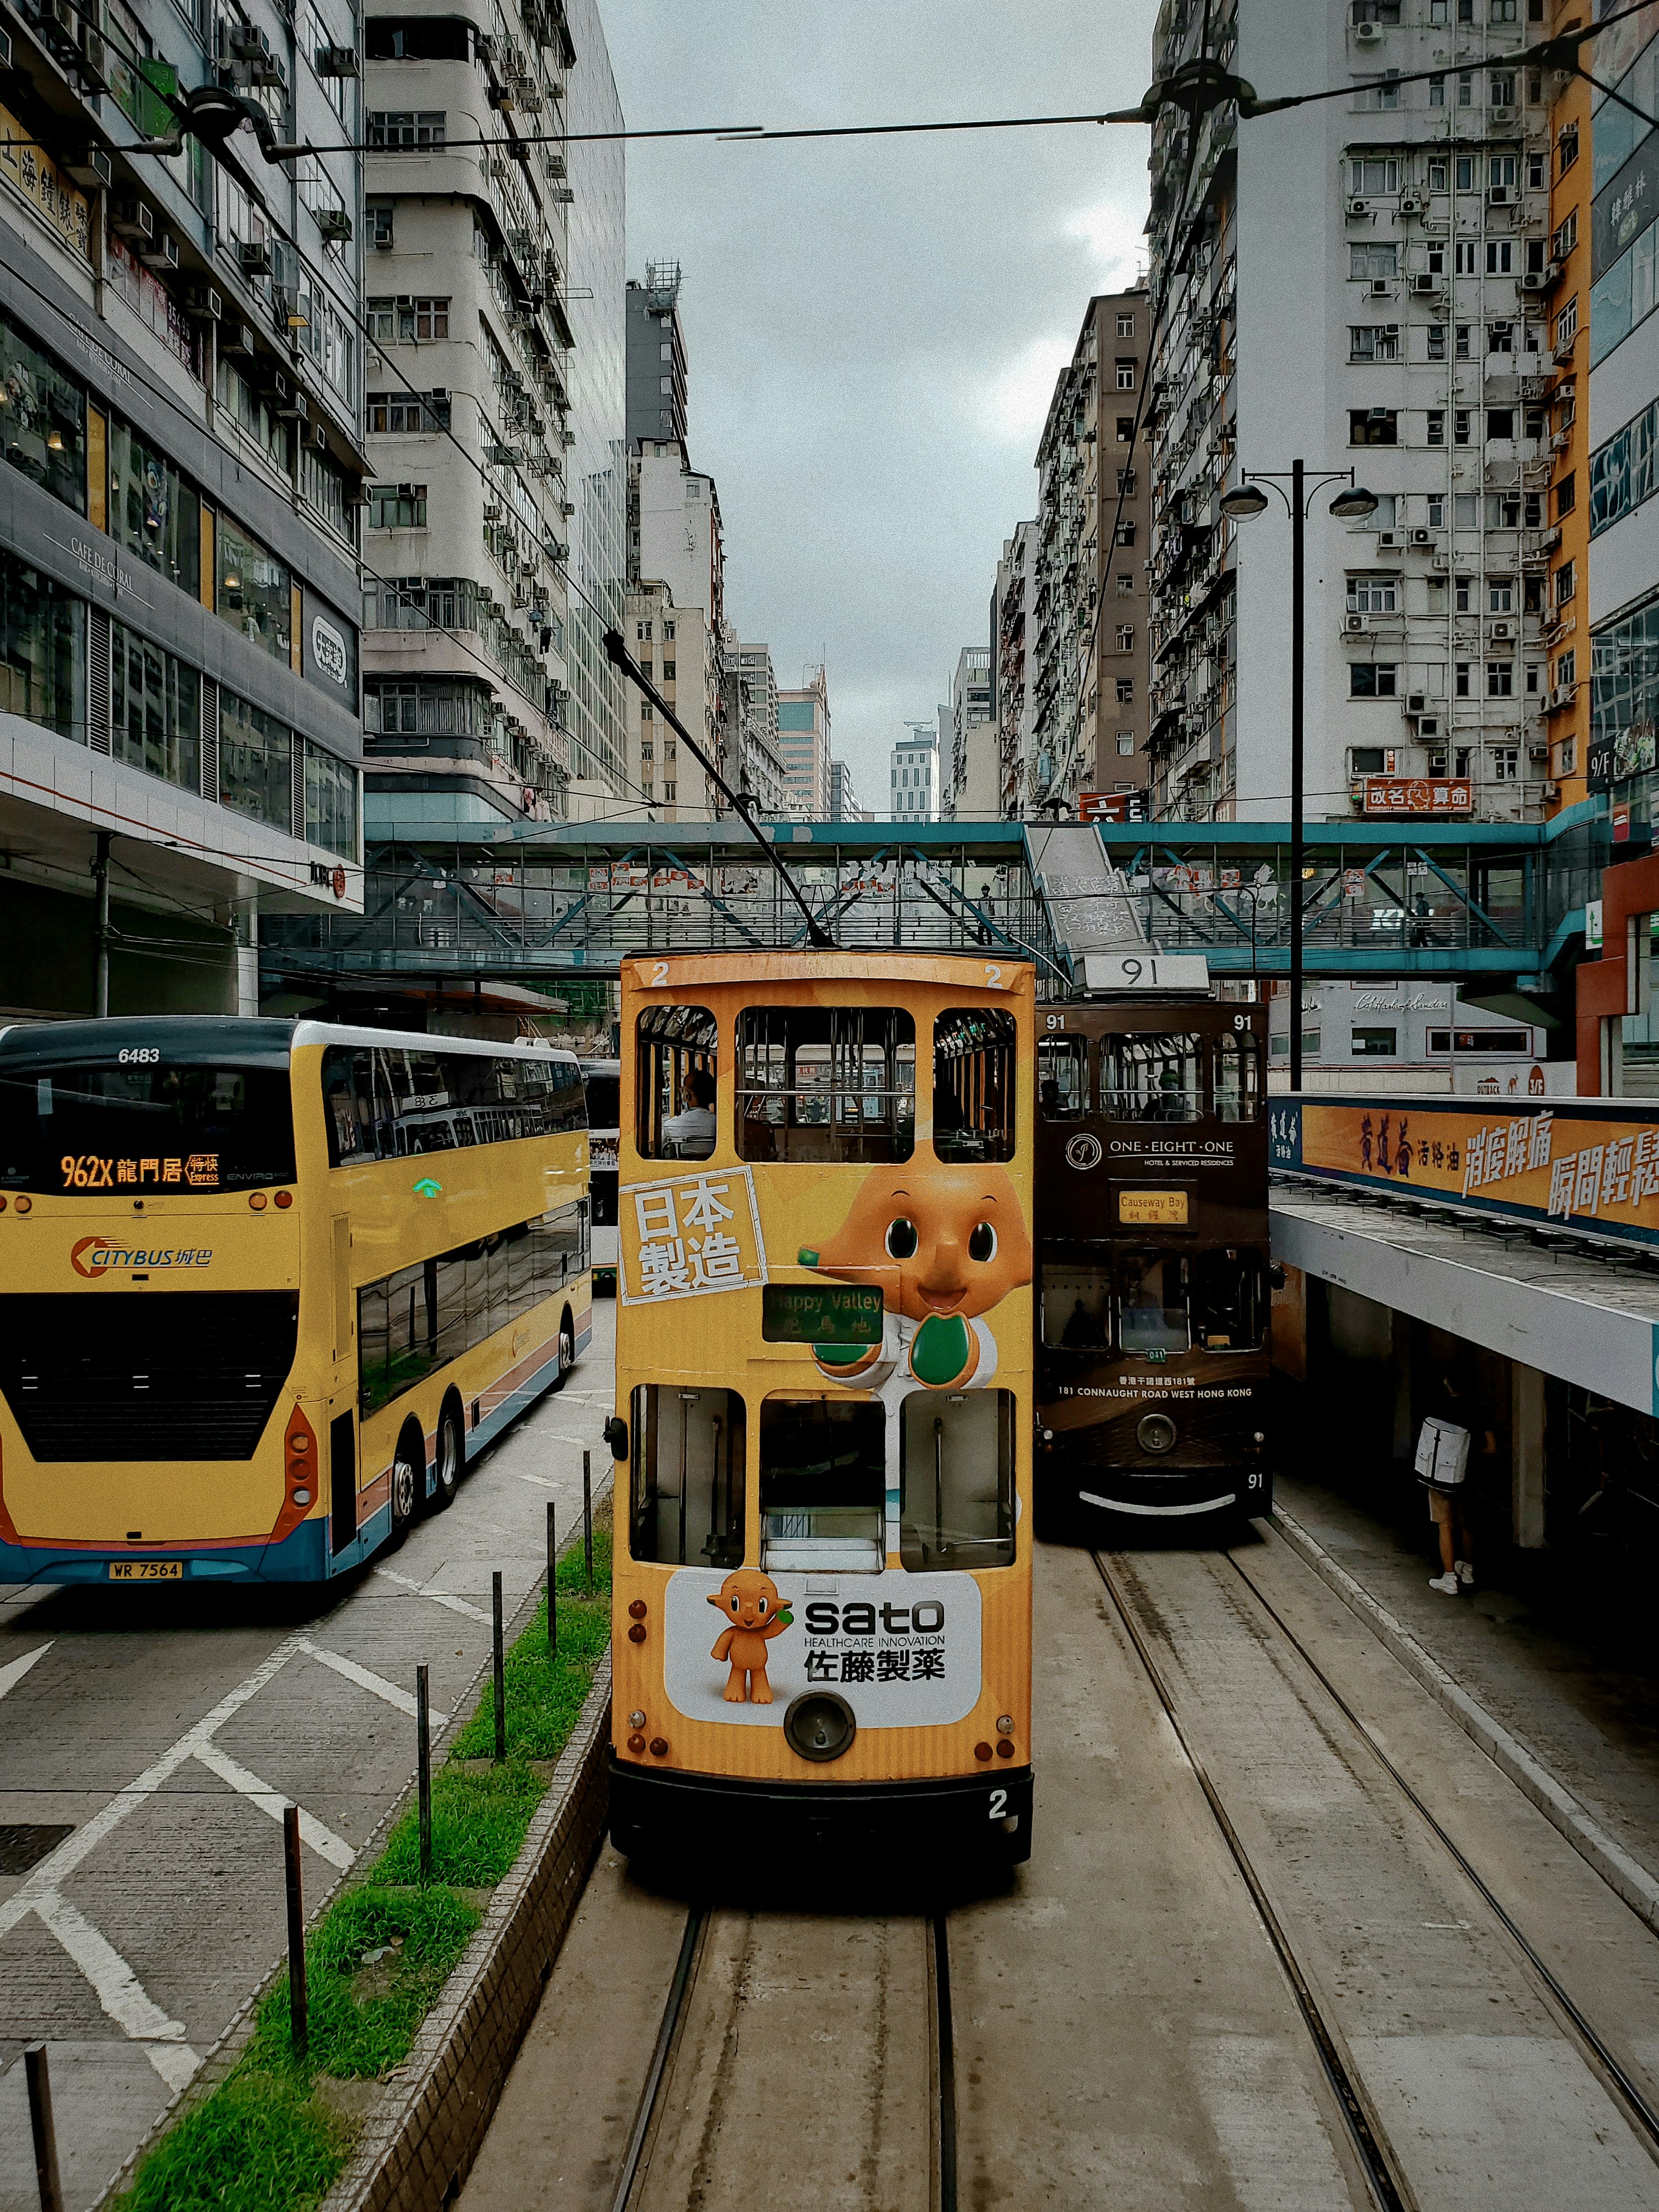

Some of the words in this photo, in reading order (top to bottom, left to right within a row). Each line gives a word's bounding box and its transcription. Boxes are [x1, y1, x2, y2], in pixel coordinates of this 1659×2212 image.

[71, 538, 92, 563] CAFE
[94, 552, 105, 572] DE
[108, 562, 133, 591] CORAL
[1370, 786, 1406, 805] 改名
[1432, 786, 1468, 805] 算命
[651, 962, 669, 986] 2
[984, 965, 1003, 988] 2
[1121, 958, 1157, 984] 91
[1046, 1014, 1065, 1030] 91
[1234, 1014, 1252, 1030] 91
[118, 1048, 160, 1063] 6483
[1110, 1141, 1142, 1152] ONE
[1152, 1141, 1197, 1152] EIGHT
[1204, 1141, 1233, 1152] ONE
[1359, 1113, 1414, 1178] 黃道益
[61, 1156, 114, 1187] 962X
[116, 1158, 182, 1183] 龍門居
[191, 1157, 219, 1172] 特快
[190, 1172, 219, 1183] Express
[635, 1180, 734, 1242] 日本
[1121, 1197, 1165, 1209] Causeway
[1169, 1197, 1184, 1209] Bay
[92, 1250, 174, 1266] CITYBUS
[175, 1248, 213, 1266] 城巴
[639, 1232, 745, 1295] 製造
[832, 1291, 882, 1313] Valley
[1058, 1386, 1074, 1395] 181
[1077, 1387, 1139, 1399] CONNAUGHT
[1141, 1390, 1169, 1399] ROAD
[1171, 1390, 1195, 1399] WEST
[1198, 1389, 1224, 1398] HONG
[1227, 1387, 1252, 1397] KONG
[1248, 1473, 1263, 1489] 91
[114, 1564, 132, 1577] WR
[140, 1564, 178, 1577] 7564
[805, 1600, 945, 1635] sato
[804, 1637, 874, 1647] HEALTHCARE
[878, 1635, 945, 1646] INNOVATION
[804, 1647, 945, 1683] 佐藤製薬
[989, 1790, 1007, 1819] 2
